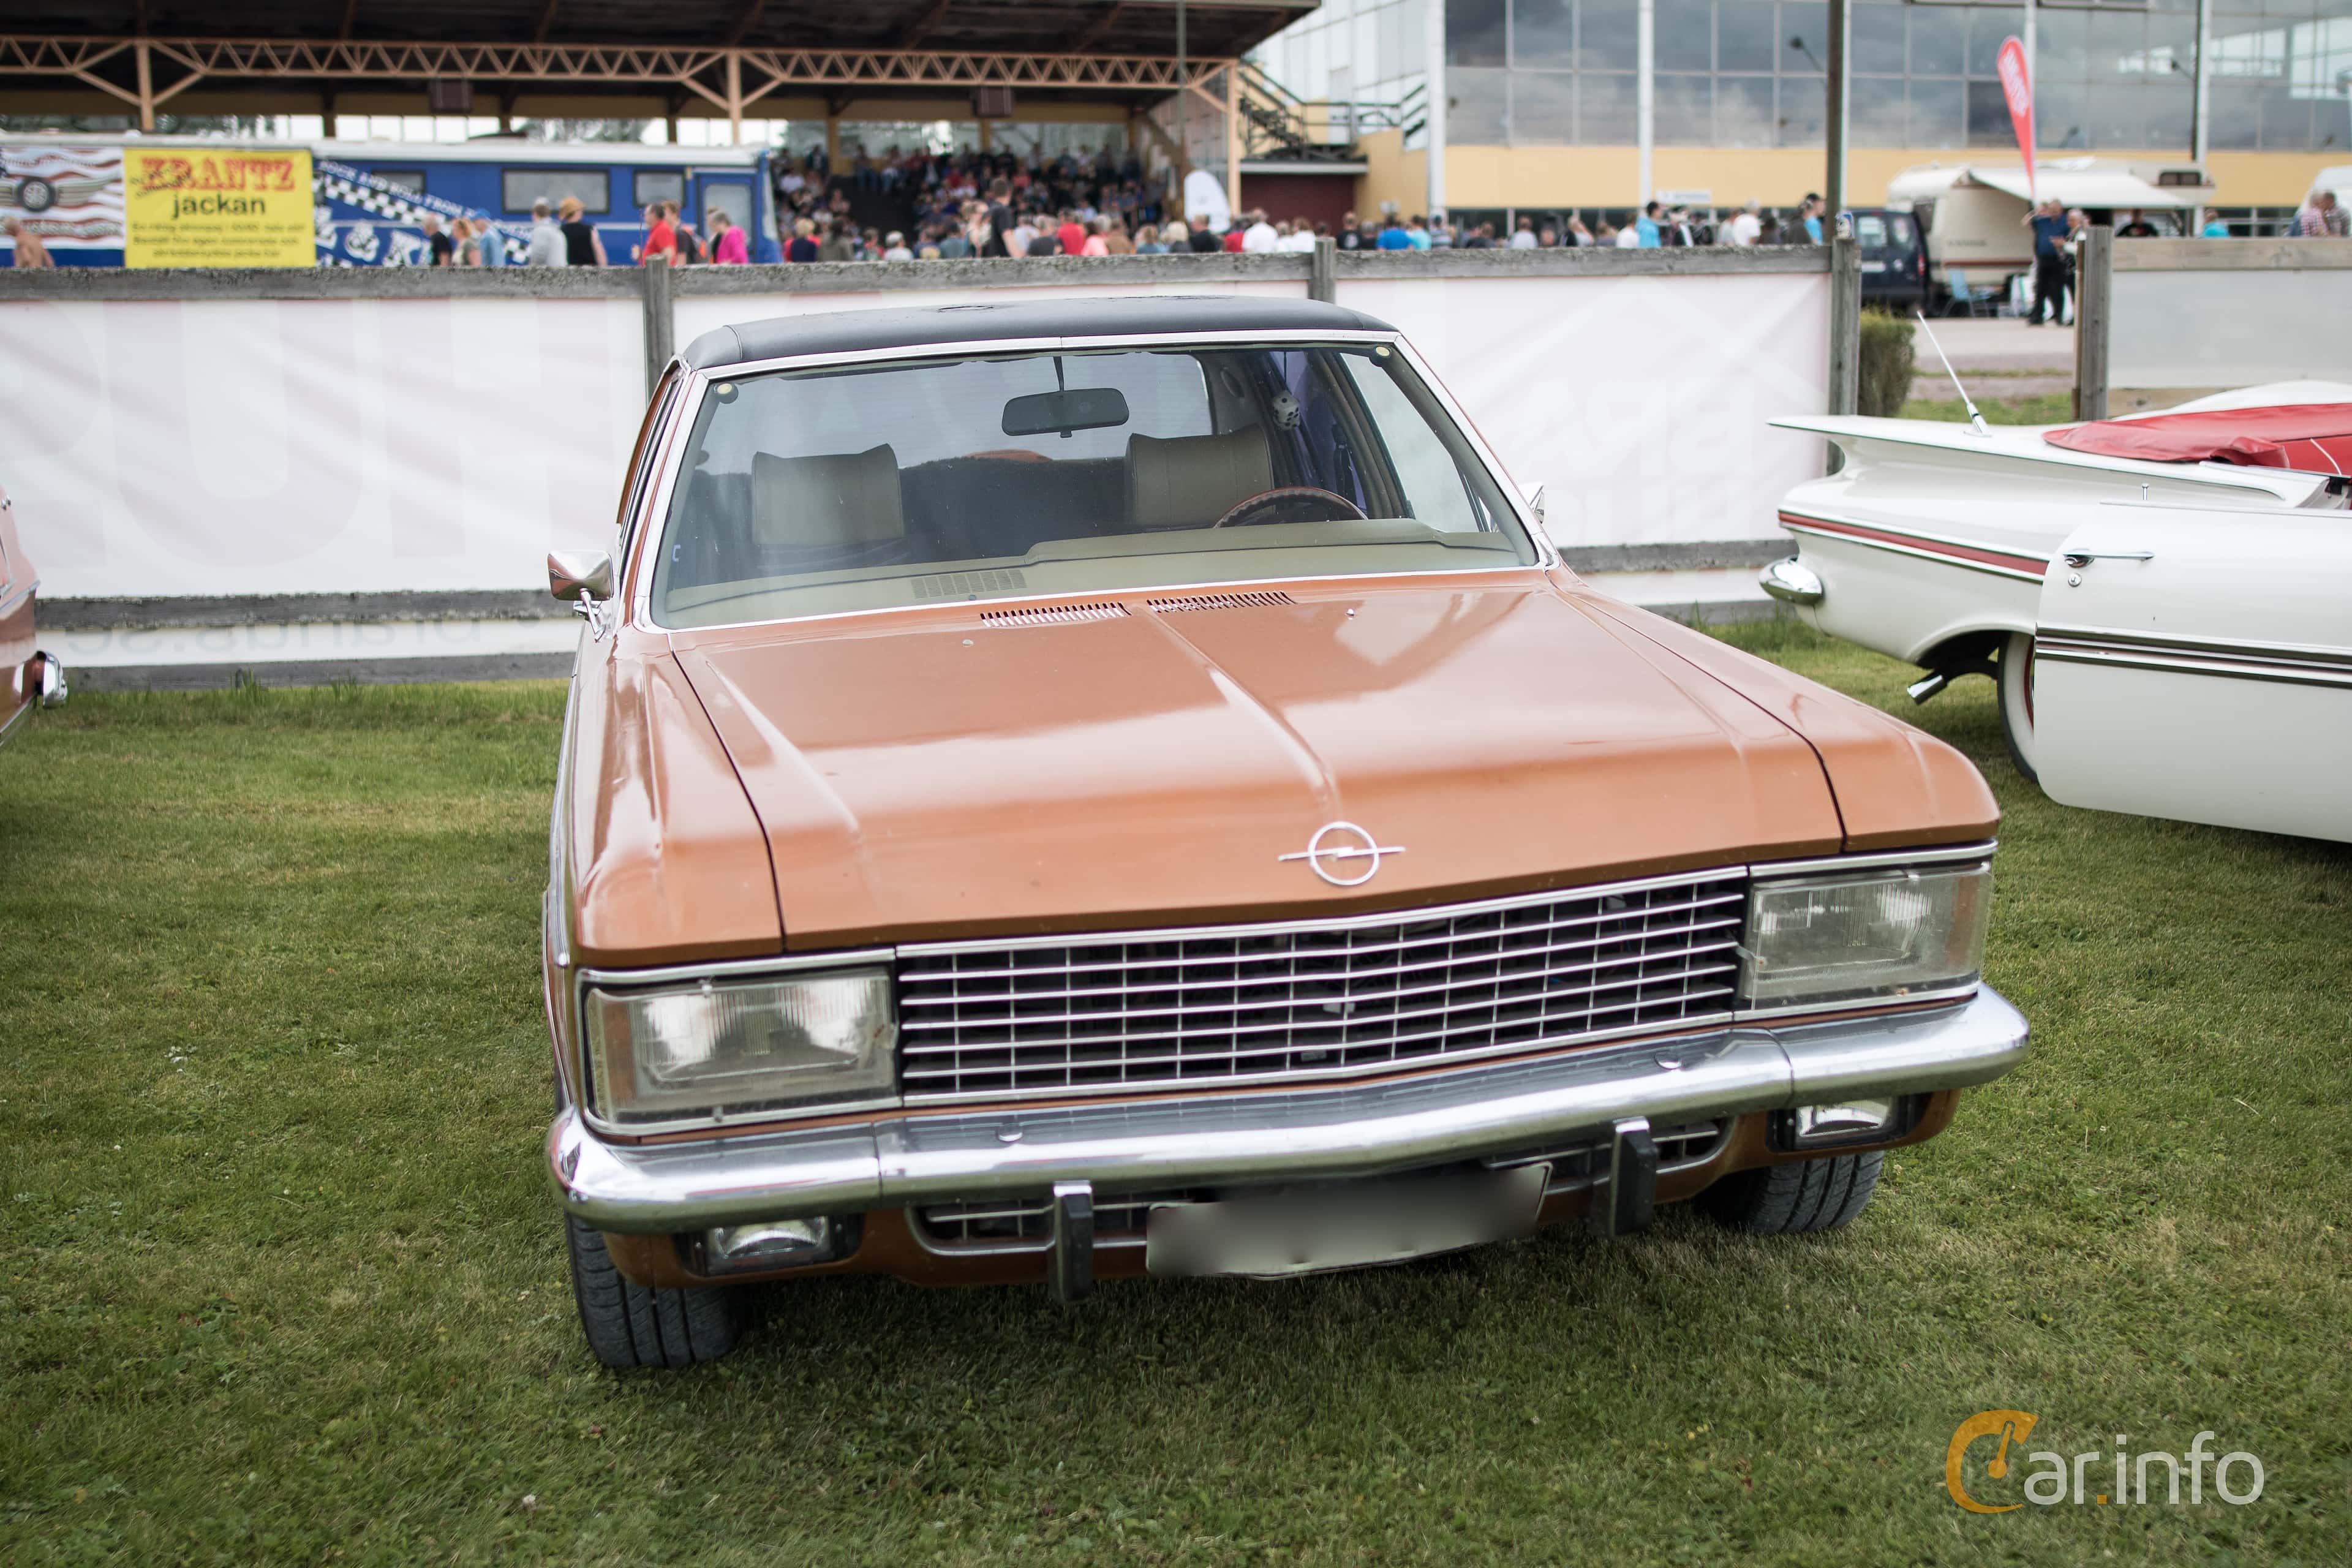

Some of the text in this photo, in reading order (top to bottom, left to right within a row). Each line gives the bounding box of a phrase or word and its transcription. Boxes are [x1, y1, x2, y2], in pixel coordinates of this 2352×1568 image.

[140, 156, 295, 191] KRANTZ
[170, 192, 266, 221] jackan
[359, 172, 388, 190] AND
[423, 194, 464, 217] FROM
